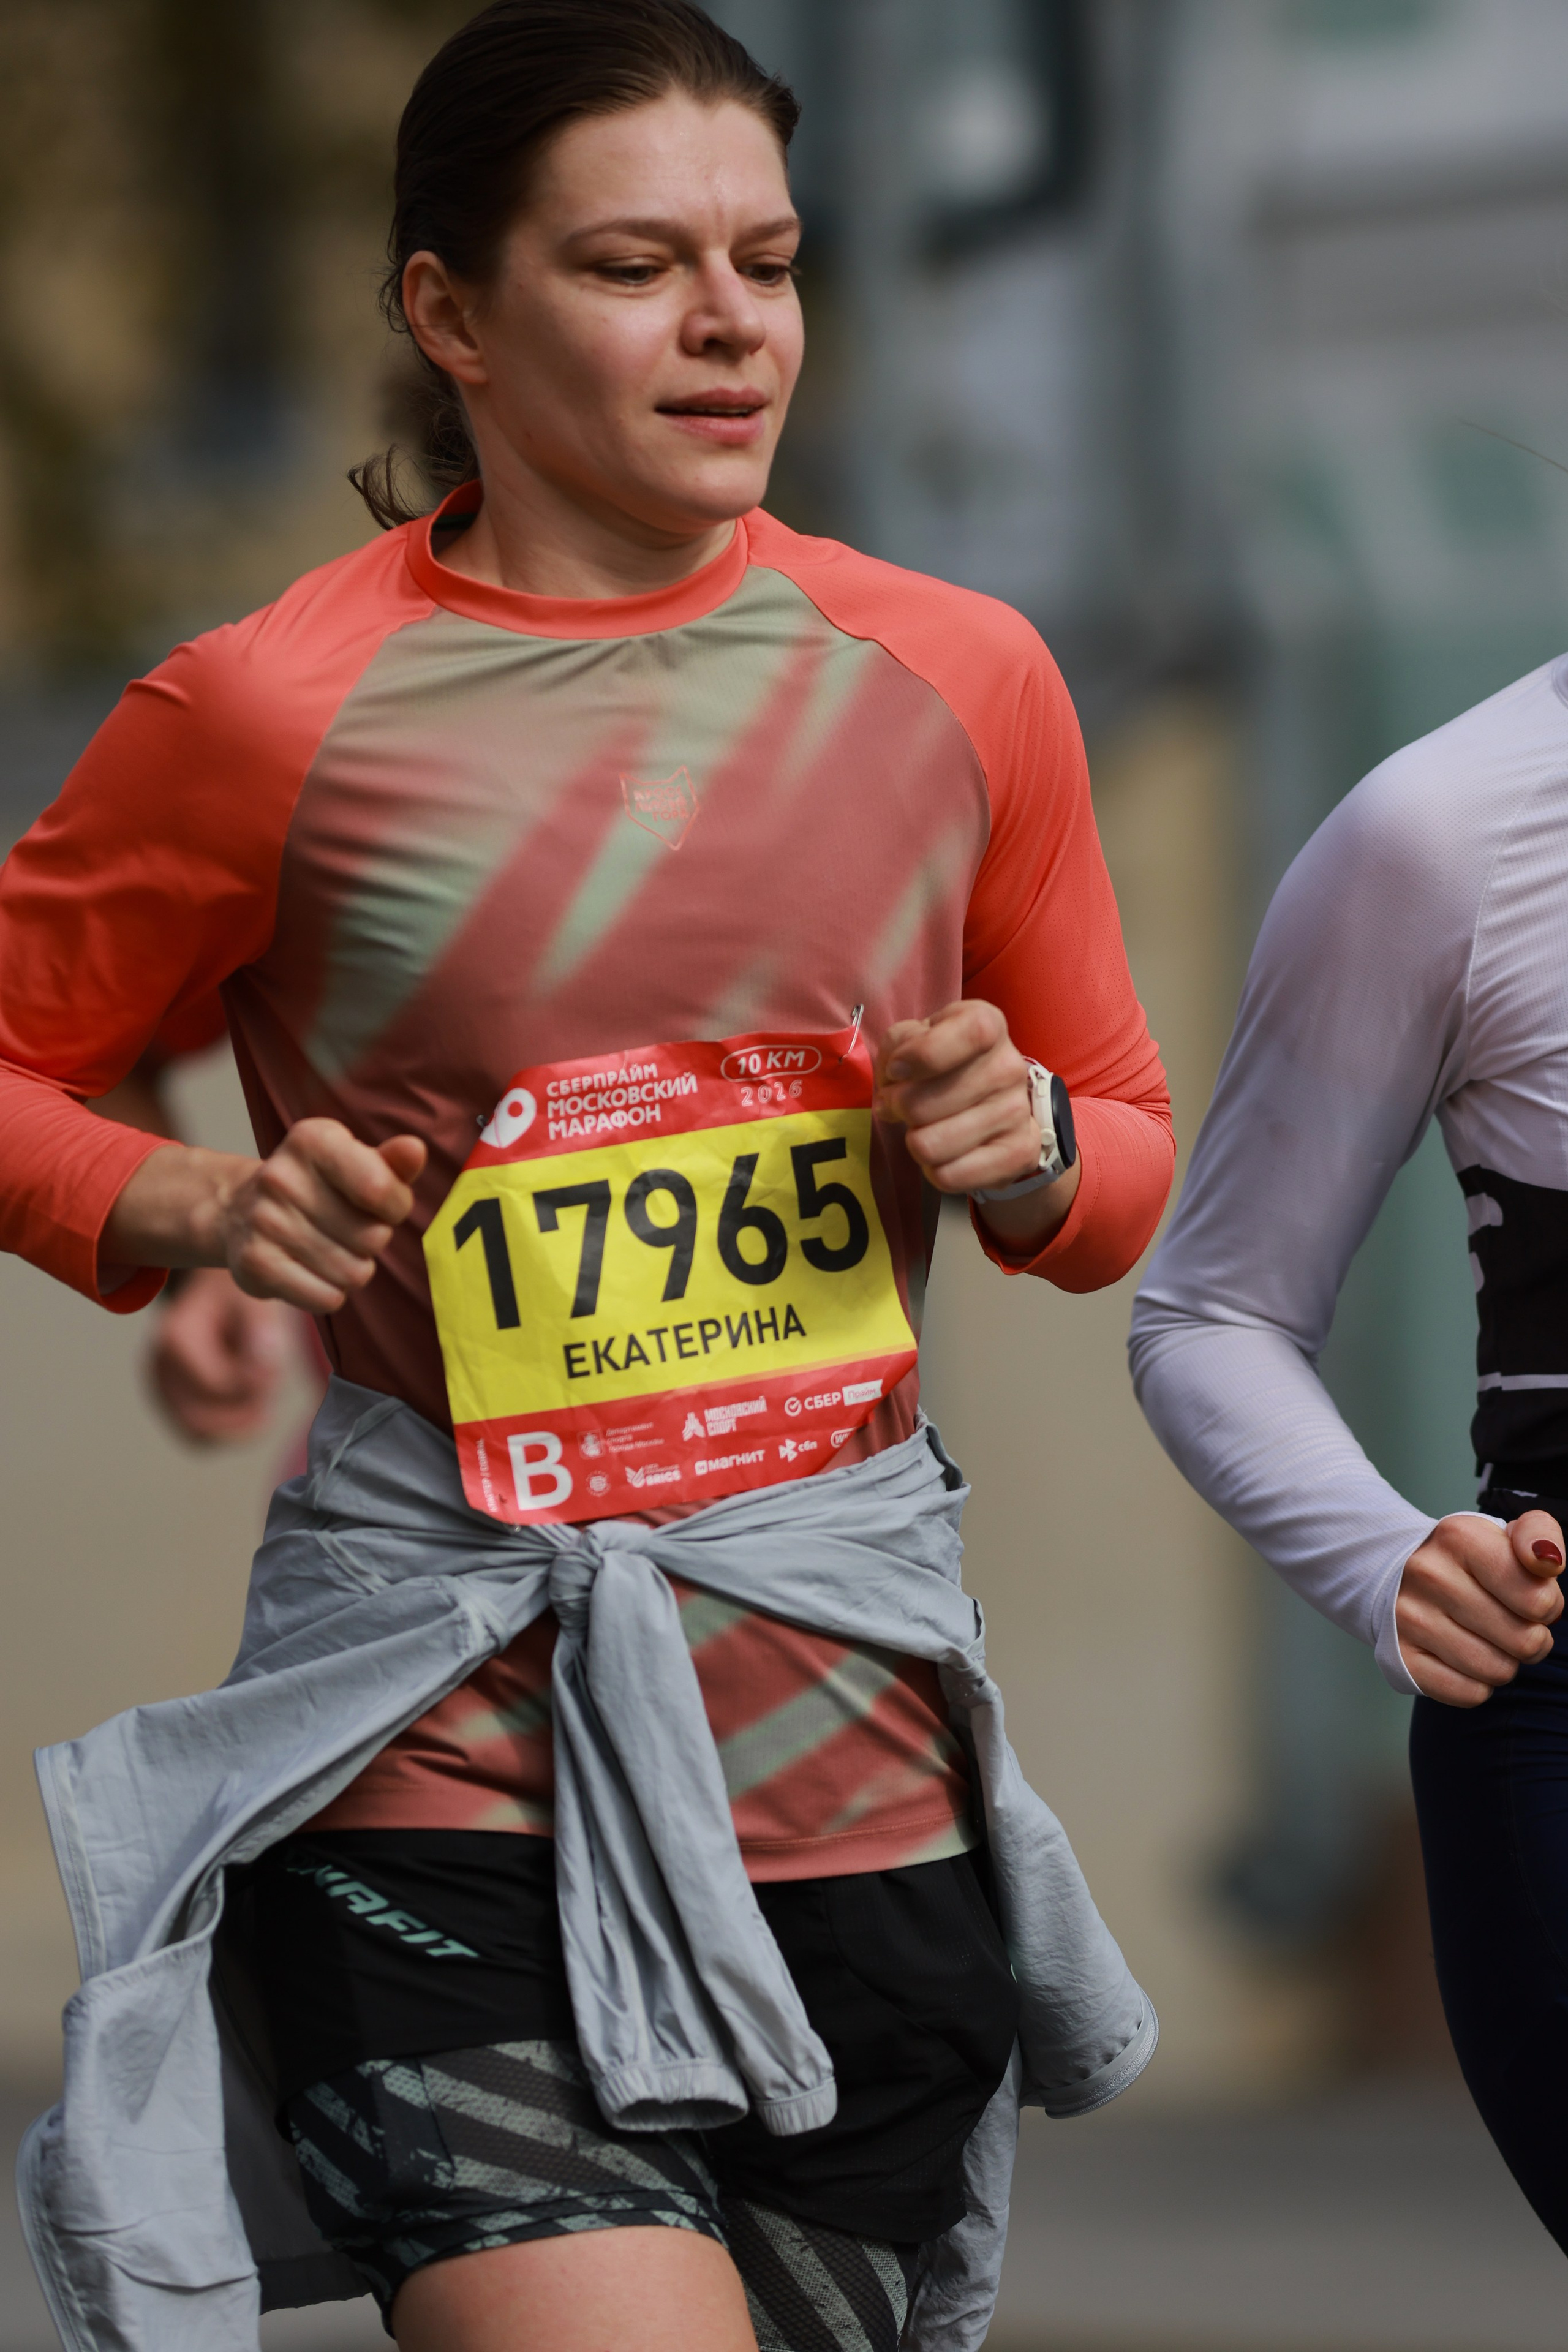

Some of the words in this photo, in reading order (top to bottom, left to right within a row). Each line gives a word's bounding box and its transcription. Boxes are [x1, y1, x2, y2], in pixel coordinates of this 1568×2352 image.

[546, 1063, 658, 1097] СБЕРПРАЙМ
[737, 1053, 761, 1075] 10
[548, 1072, 698, 1118] МОСКОВСКИЙ
[741, 1079, 802, 1107] 2026
[548, 1103, 661, 1140] МАРАФОН
[453, 1137, 869, 1330] 17965
[564, 1303, 806, 1379] ЕКАТЕРИНА
[804, 1392, 841, 1410] СБЕР
